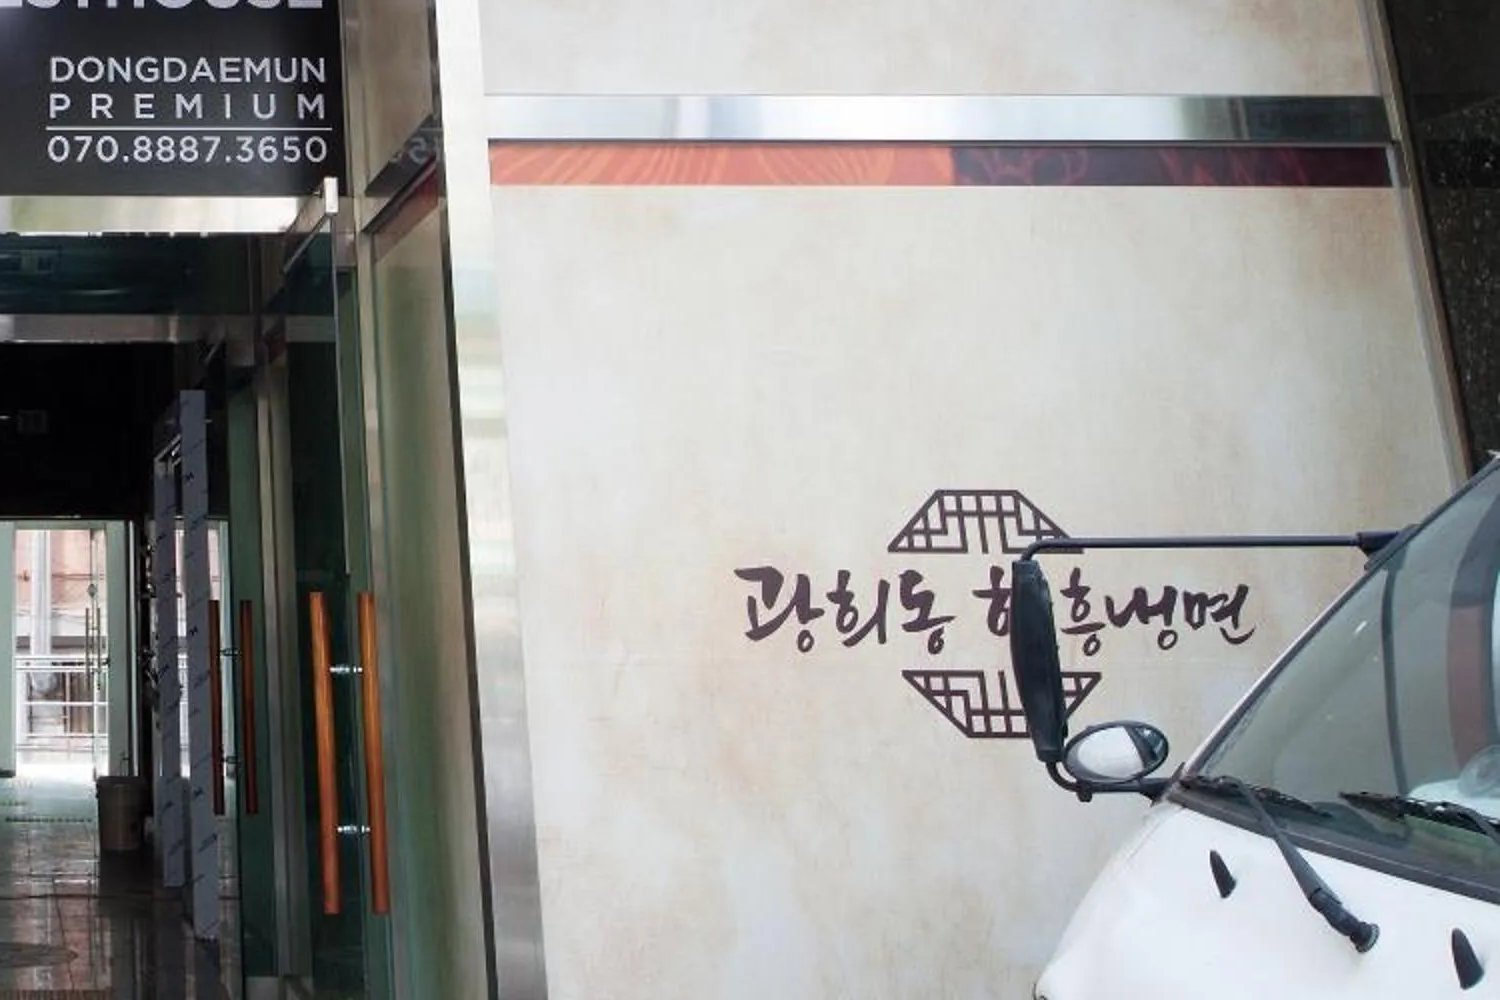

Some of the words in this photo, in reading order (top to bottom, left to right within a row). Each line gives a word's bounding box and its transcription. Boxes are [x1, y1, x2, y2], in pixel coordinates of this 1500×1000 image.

[49, 56, 326, 84] DONGDAEMUN
[48, 93, 326, 121] PREMIUM
[46, 134, 328, 164] 070.8887.3650
